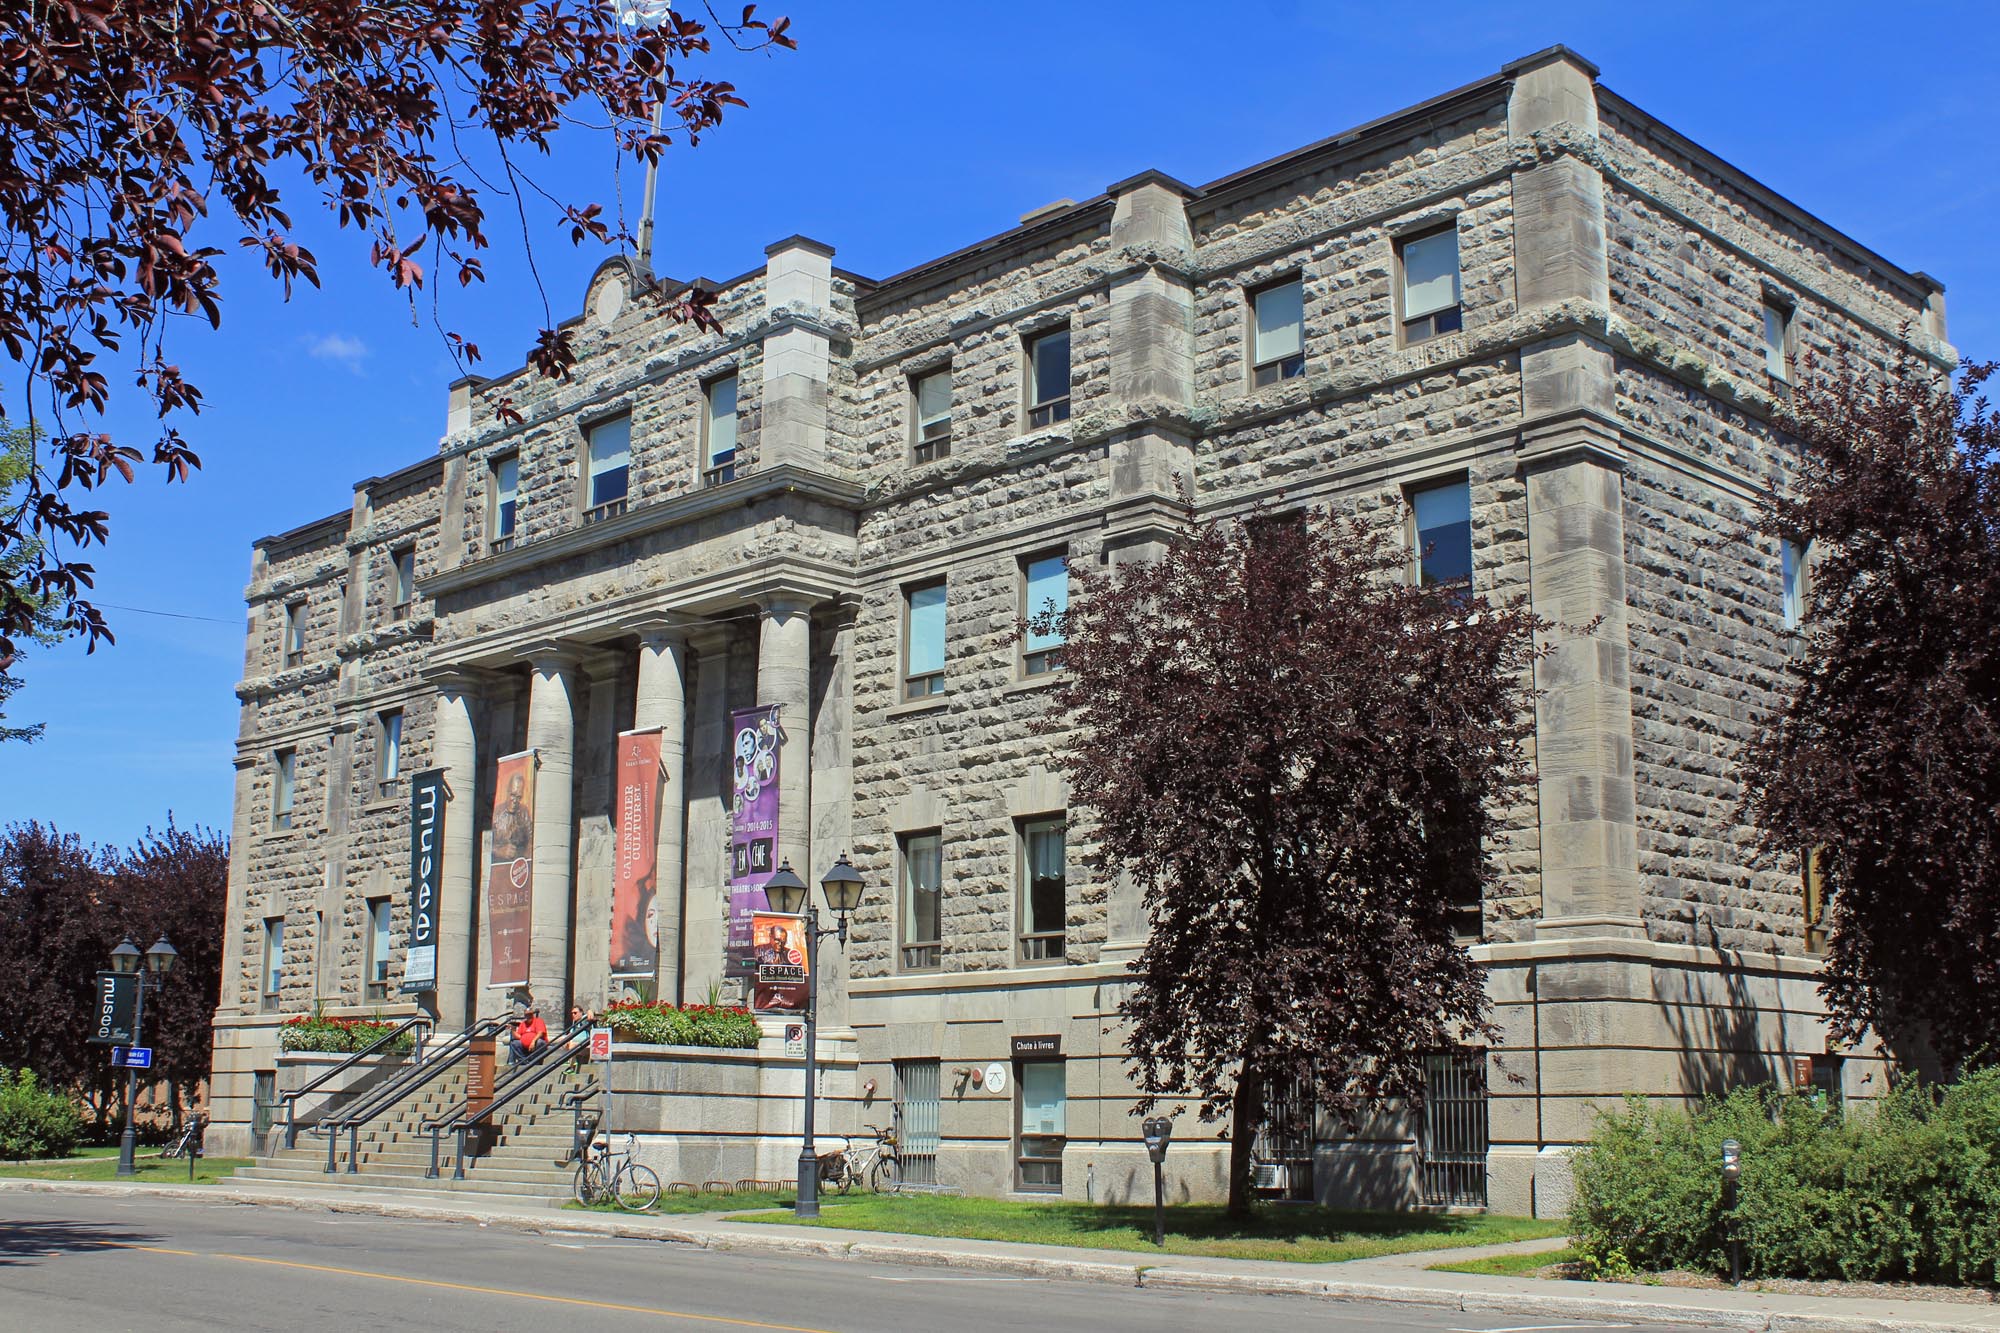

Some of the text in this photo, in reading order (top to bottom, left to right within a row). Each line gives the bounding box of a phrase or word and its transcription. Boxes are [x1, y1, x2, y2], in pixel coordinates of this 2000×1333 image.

[632, 783, 642, 861] CULTUREL
[747, 820, 773, 832] 2014-2015
[623, 784, 634, 879] CALENDRIER
[738, 849, 746, 872] EN
[489, 890, 529, 906] ESPACE
[761, 966, 803, 976] ESPACE
[597, 1039, 607, 1049] 2
[1016, 1040, 1054, 1050] Chute à livres
